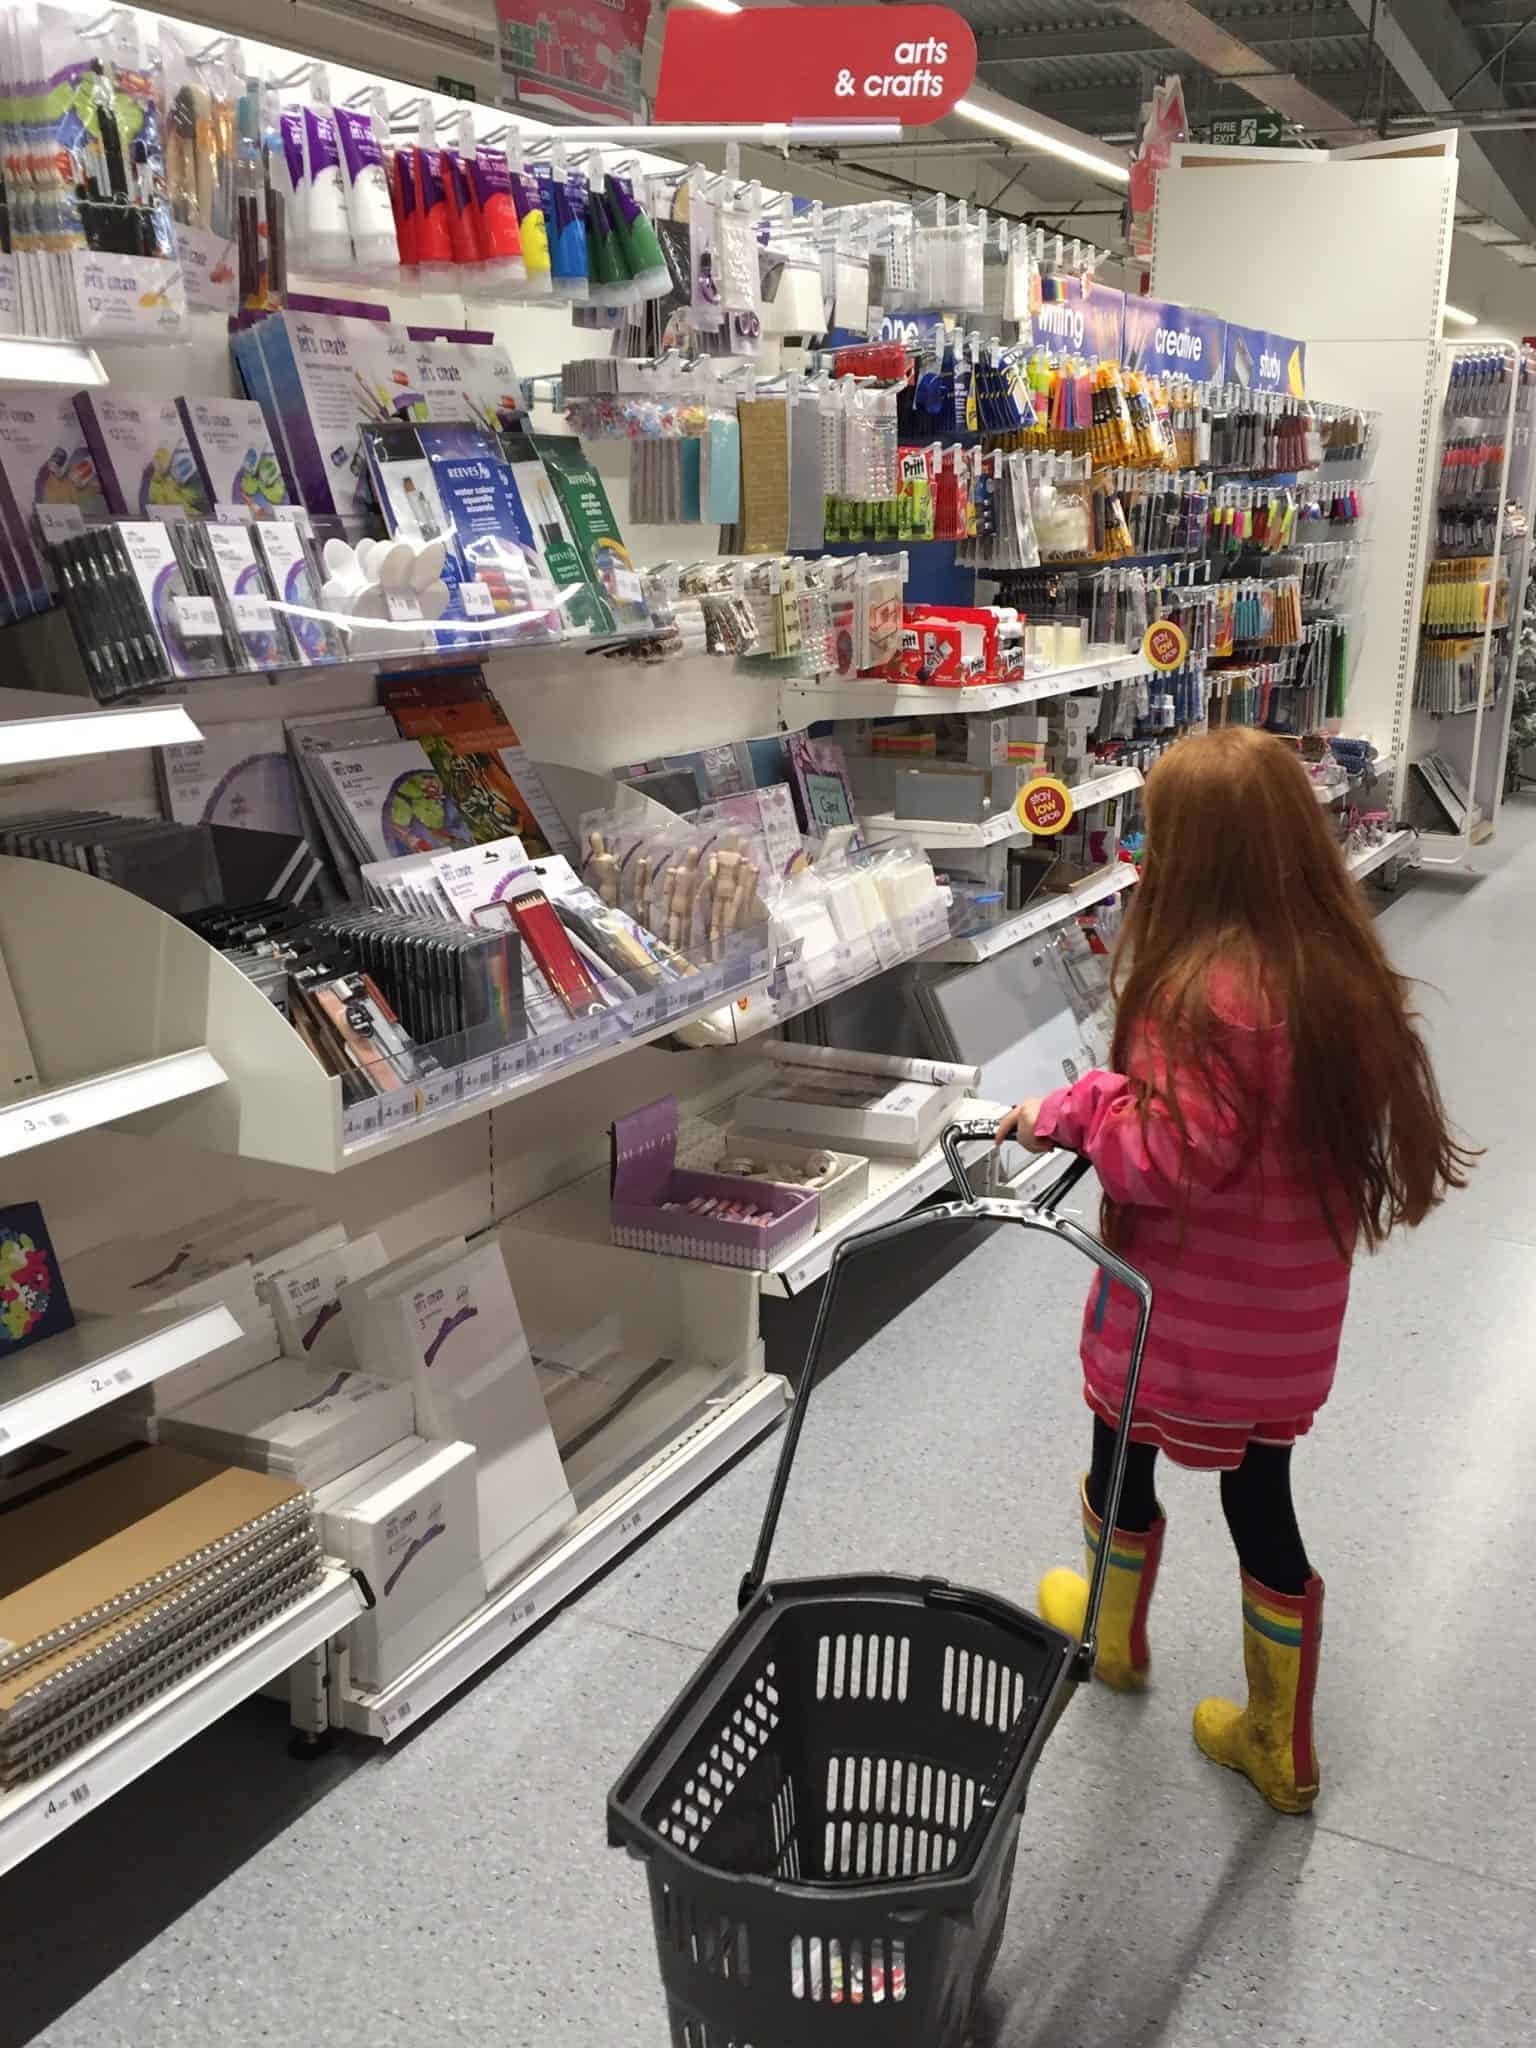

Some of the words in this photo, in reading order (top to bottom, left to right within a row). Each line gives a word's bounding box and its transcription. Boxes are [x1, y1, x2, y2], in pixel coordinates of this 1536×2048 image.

[894, 36, 949, 65] arts
[834, 68, 857, 97] &
[863, 68, 945, 97] crafts
[1213, 121, 1238, 133] FIRE
[1213, 134, 1237, 144] EXIT
[1038, 302, 1085, 349] writing
[1154, 326, 1203, 362] creative
[1259, 348, 1282, 386] study
[903, 458, 925, 477] Pritt
[901, 631, 917, 648] ritt
[1030, 788, 1052, 805] stay
[1032, 799, 1057, 817] low
[1038, 809, 1062, 827] price
